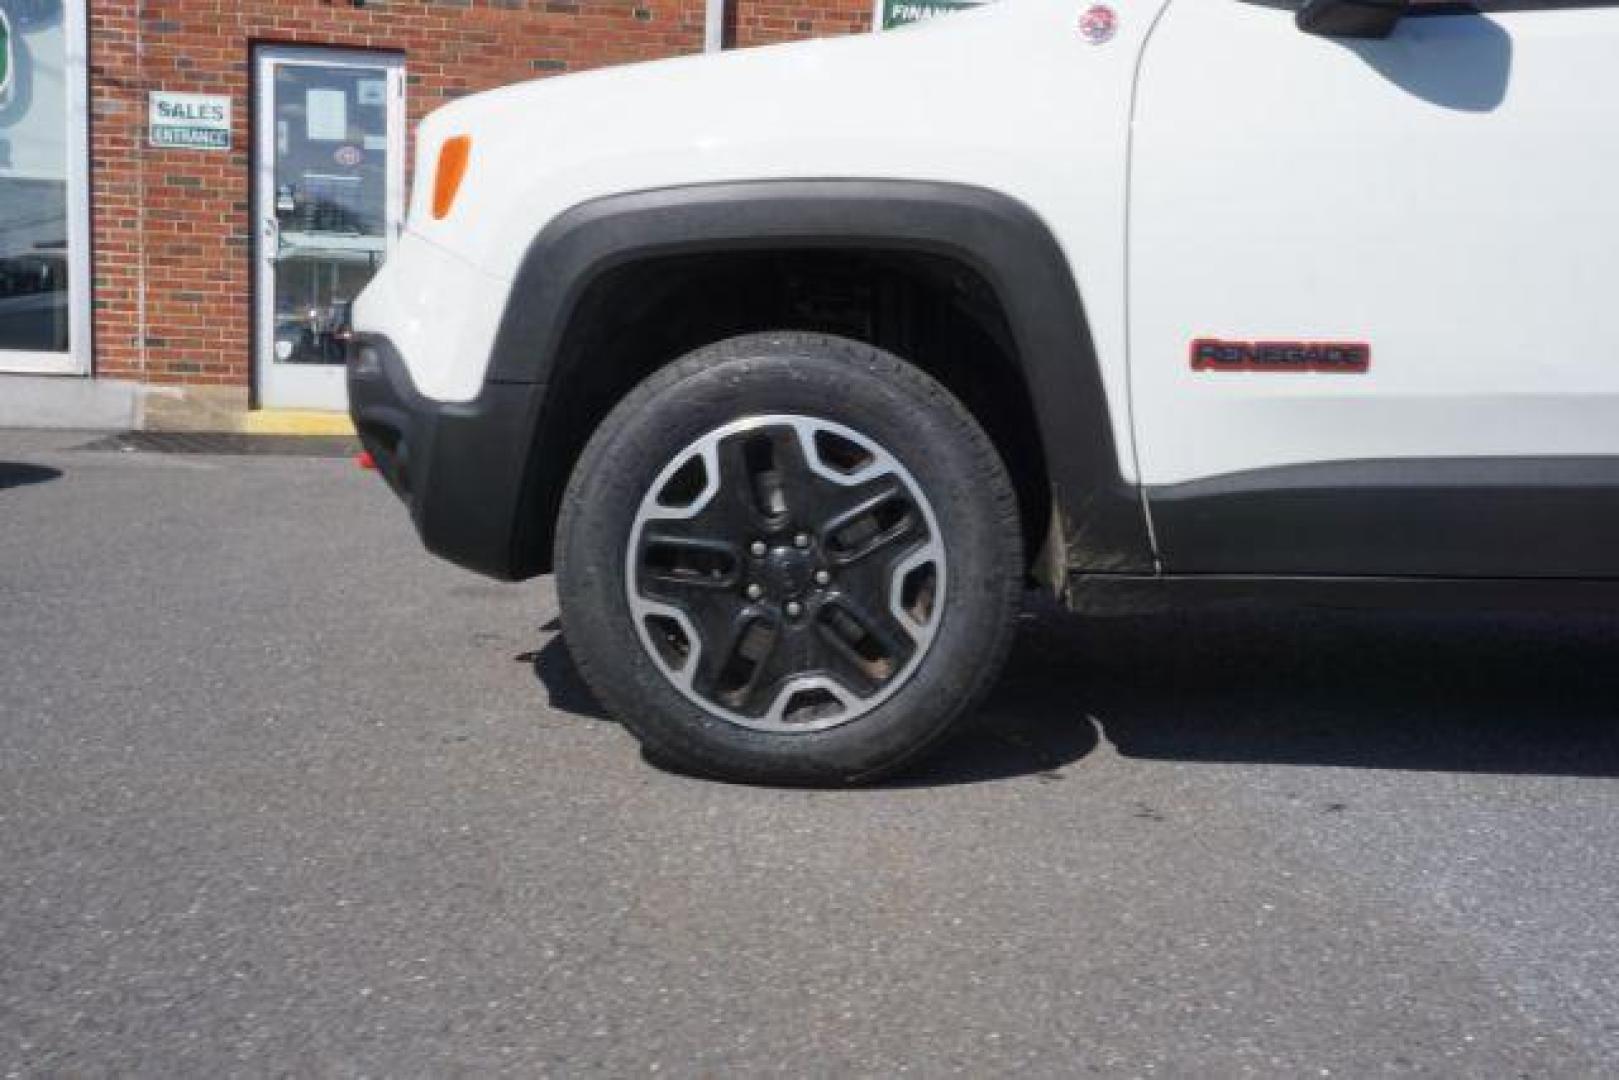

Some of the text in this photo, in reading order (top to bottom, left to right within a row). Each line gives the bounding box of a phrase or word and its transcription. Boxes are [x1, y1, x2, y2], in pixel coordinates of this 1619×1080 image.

[157, 101, 224, 120] SALES
[153, 127, 228, 145] ENTRANCE
[1193, 342, 1368, 370] RENEGADE
